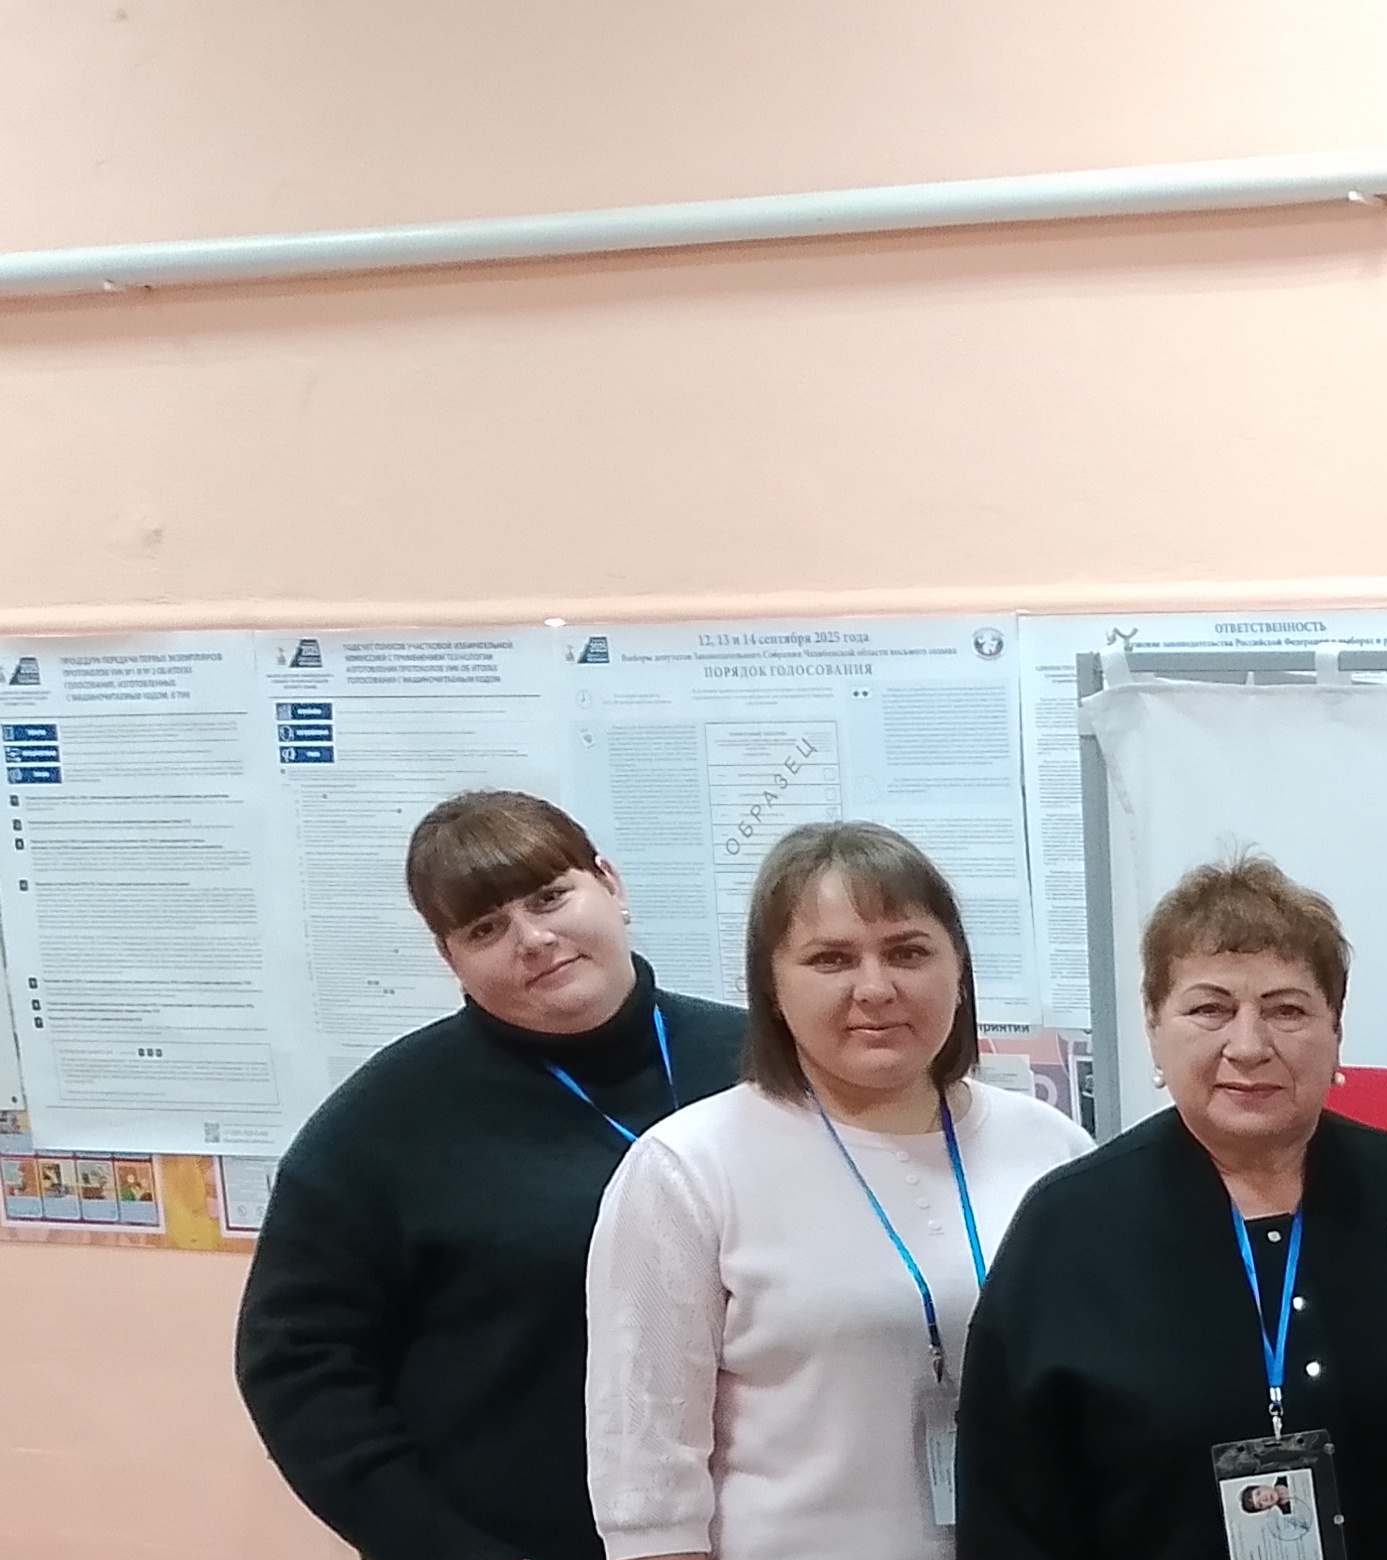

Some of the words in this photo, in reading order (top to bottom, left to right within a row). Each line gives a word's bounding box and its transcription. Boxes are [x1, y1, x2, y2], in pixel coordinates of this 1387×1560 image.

[1215, 622, 1326, 634] ОТВЕТСТВЕННОСТЬ
[718, 635, 729, 646] 13
[743, 634, 756, 645] 14
[758, 632, 811, 647] сентября
[814, 631, 840, 643] 2025
[843, 632, 869, 645] года
[704, 665, 766, 680] ПОРЯДОК
[770, 664, 873, 677] ГОЛОСОВАНИЯ
[726, 737, 818, 855] ОБРАЗЕЦ
